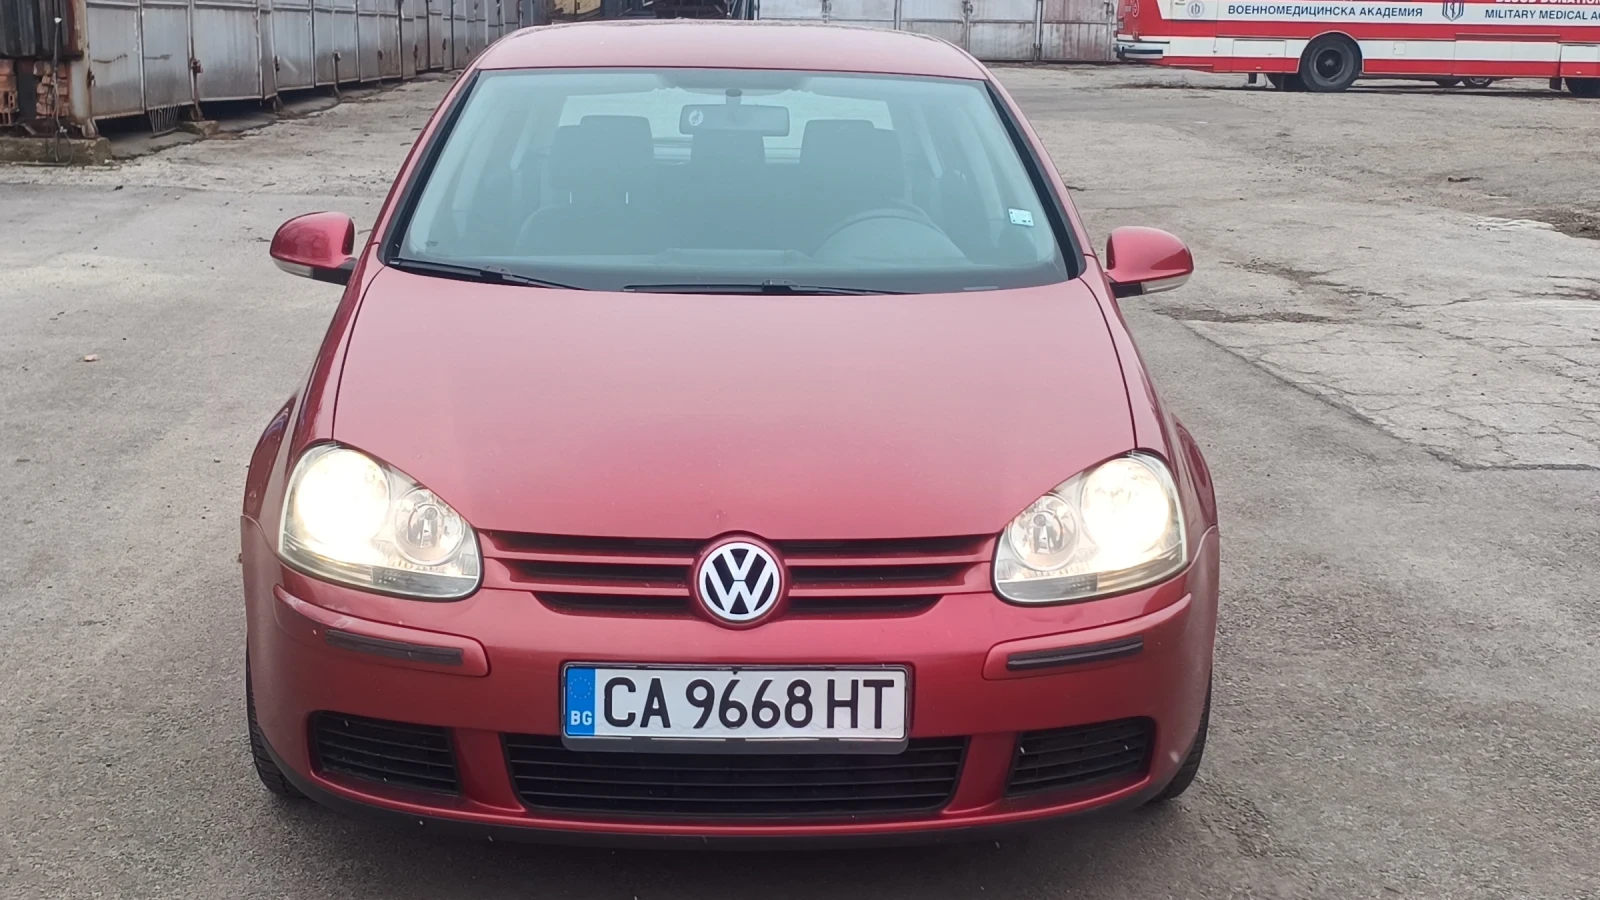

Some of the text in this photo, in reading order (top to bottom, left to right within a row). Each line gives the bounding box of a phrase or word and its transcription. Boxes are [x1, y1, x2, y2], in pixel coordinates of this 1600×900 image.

[1228, 5, 1423, 18] ВОЕННОМЕДИЦИНСКА АКАДЕМИЯ
[1485, 9, 1536, 19] MILITARY
[1539, 10, 1588, 20] MEDICAL
[604, 677, 895, 729] CA 9668 HT
[570, 710, 593, 726] BG
